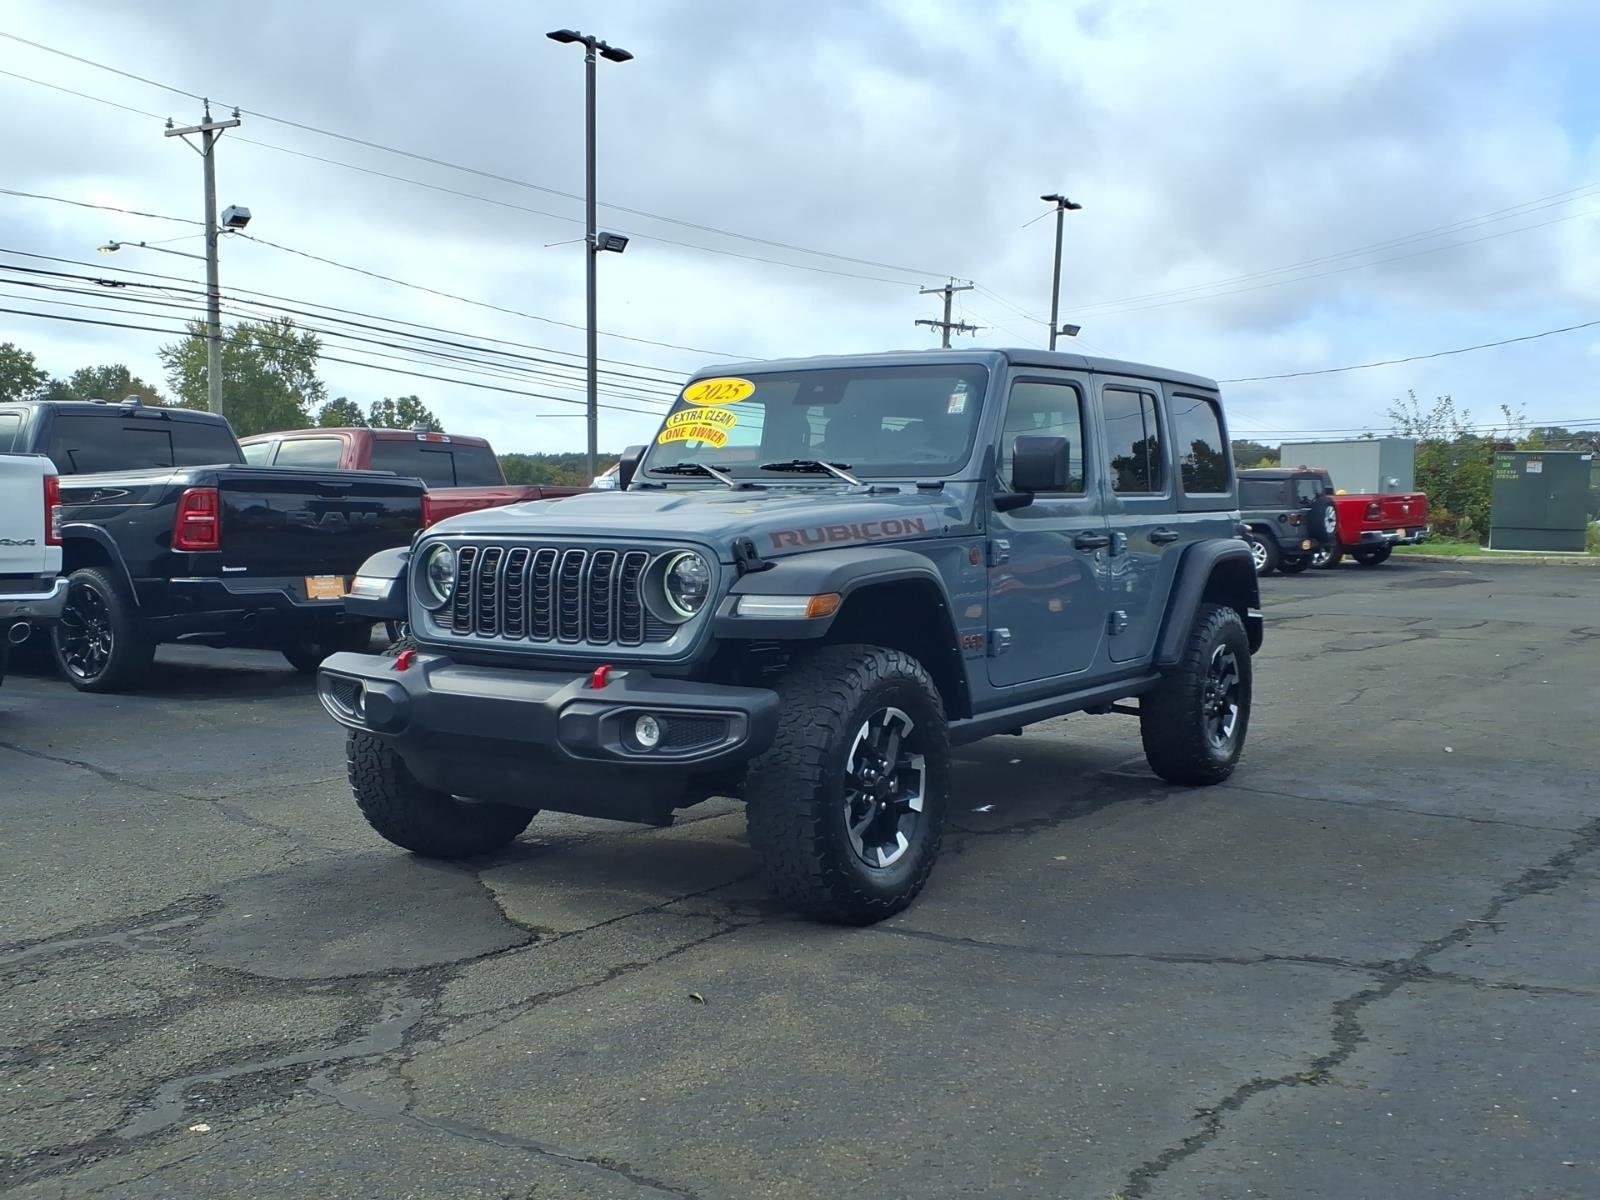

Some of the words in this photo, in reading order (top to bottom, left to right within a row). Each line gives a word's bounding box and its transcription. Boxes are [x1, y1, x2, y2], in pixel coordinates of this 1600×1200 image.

[692, 383, 746, 401] 2025
[673, 410, 702, 423] EXTRA
[704, 409, 734, 426] CLEAN
[665, 427, 687, 440] ONE
[689, 426, 725, 444] OWNER
[286, 510, 378, 528] RAM
[768, 518, 928, 549] RUBICON
